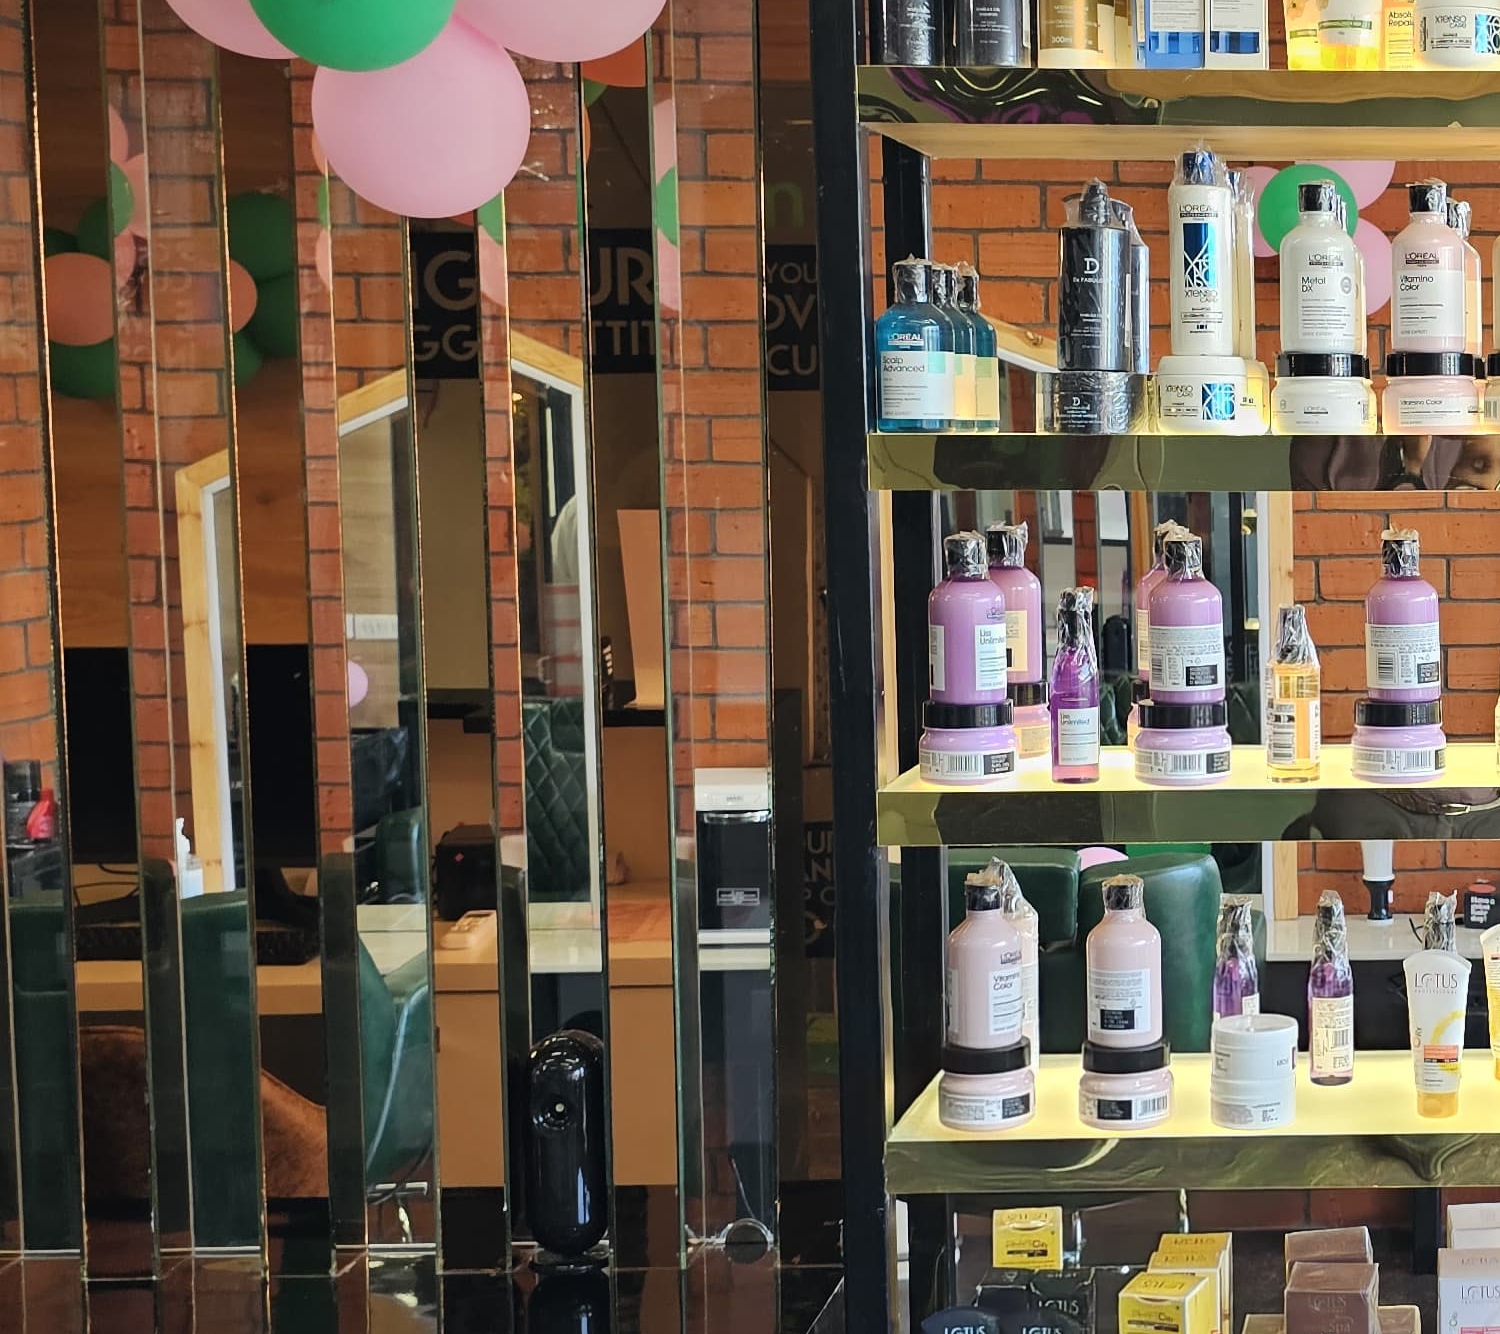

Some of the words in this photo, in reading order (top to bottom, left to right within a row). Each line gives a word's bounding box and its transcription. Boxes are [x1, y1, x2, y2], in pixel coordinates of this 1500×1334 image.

[1301, 276, 1326, 284] Metal
[1400, 275, 1434, 284] Vitamino
[1301, 284, 1313, 293] DX
[1400, 283, 1420, 292] Color
[883, 356, 904, 365] Scalp
[1415, 973, 1458, 988] LOTUS
